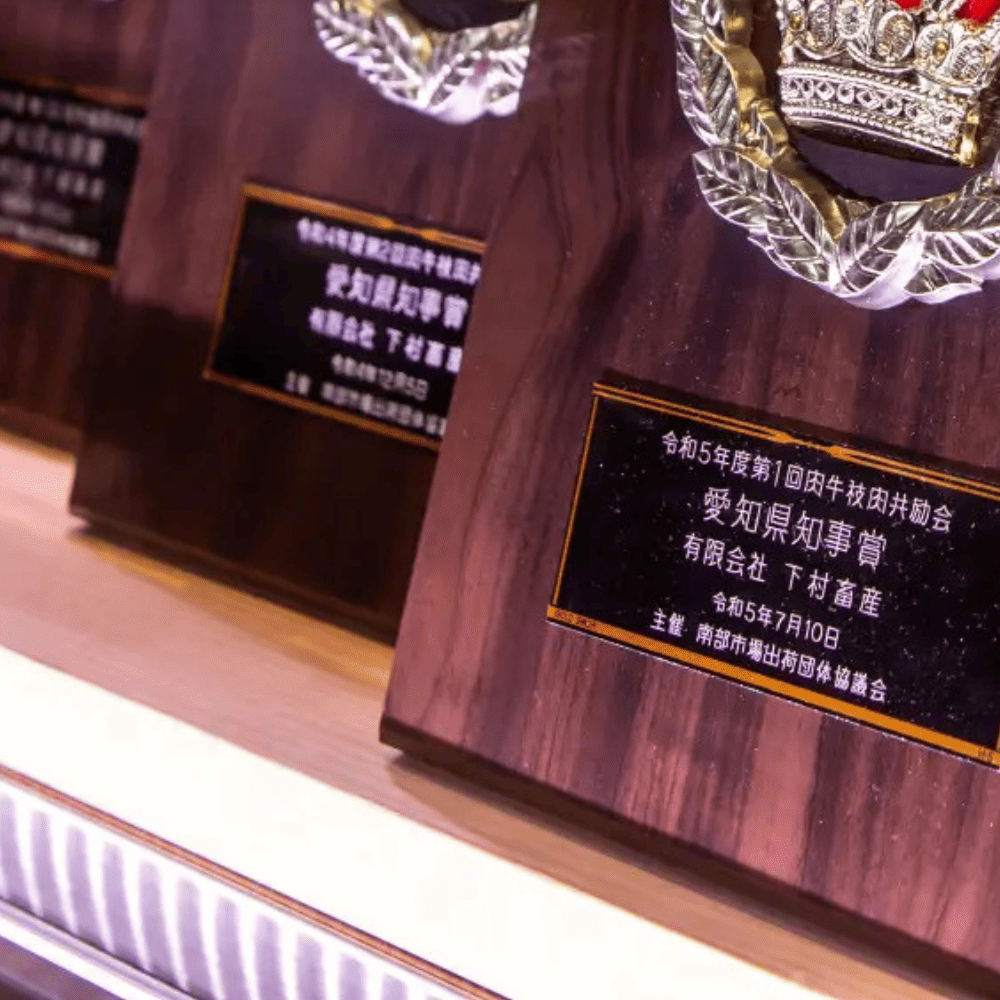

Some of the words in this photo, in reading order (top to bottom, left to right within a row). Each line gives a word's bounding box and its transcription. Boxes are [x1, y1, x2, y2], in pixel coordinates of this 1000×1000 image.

[663, 431, 952, 532] 令和5年度第1回肉牛枝肉共励会
[704, 487, 886, 570] 愛知県知事賞
[684, 533, 767, 582] 有限会社
[785, 563, 881, 617] 下村畜産
[650, 608, 684, 637] 主催
[713, 592, 839, 649] 令和5年7月10日
